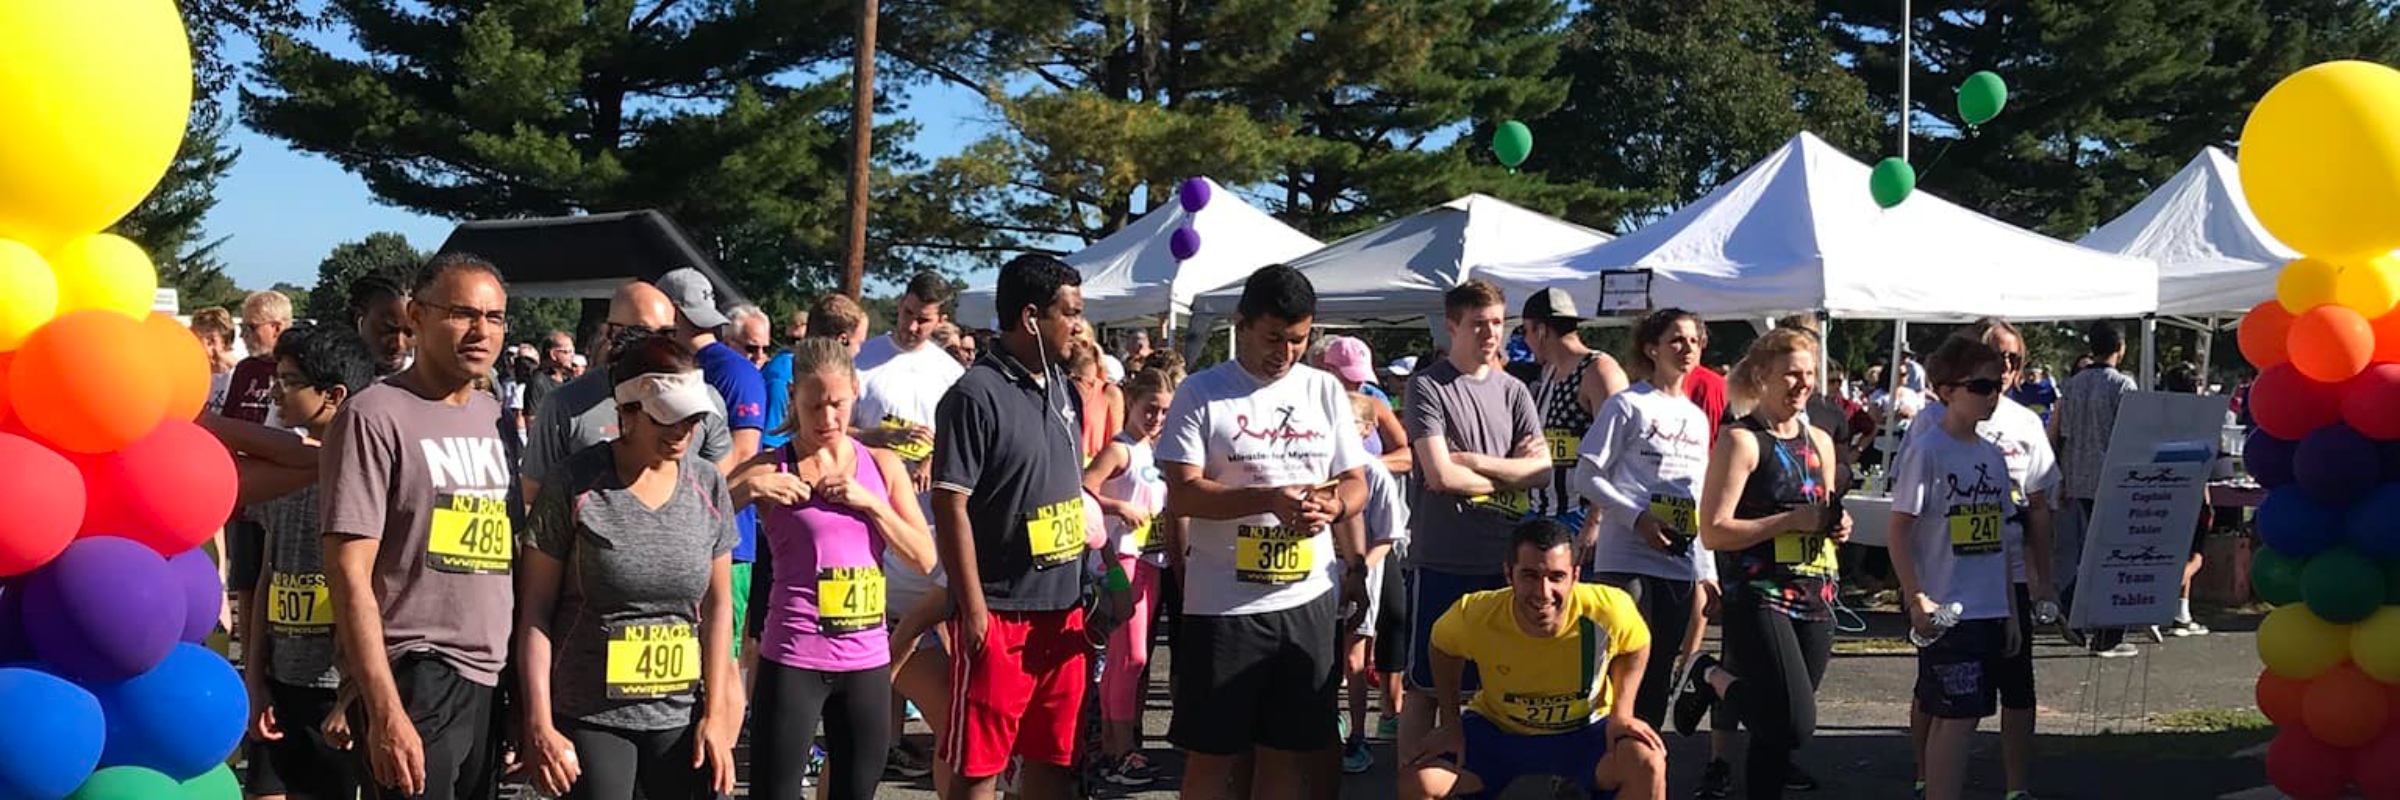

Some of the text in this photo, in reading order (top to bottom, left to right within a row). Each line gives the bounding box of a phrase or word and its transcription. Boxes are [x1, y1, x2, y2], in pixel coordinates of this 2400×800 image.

[453, 495, 474, 512] NJ
[1037, 505, 1054, 520] NJ
[460, 517, 504, 555] 489
[1970, 515, 1998, 541] 247
[1258, 542, 1300, 570] 306
[282, 574, 326, 588] RACES
[833, 567, 850, 580] NJ
[278, 590, 315, 622] 507
[843, 582, 876, 613] 413
[625, 624, 691, 641] NJ RACES
[635, 644, 684, 679] 490
[1526, 704, 1569, 722] 277
